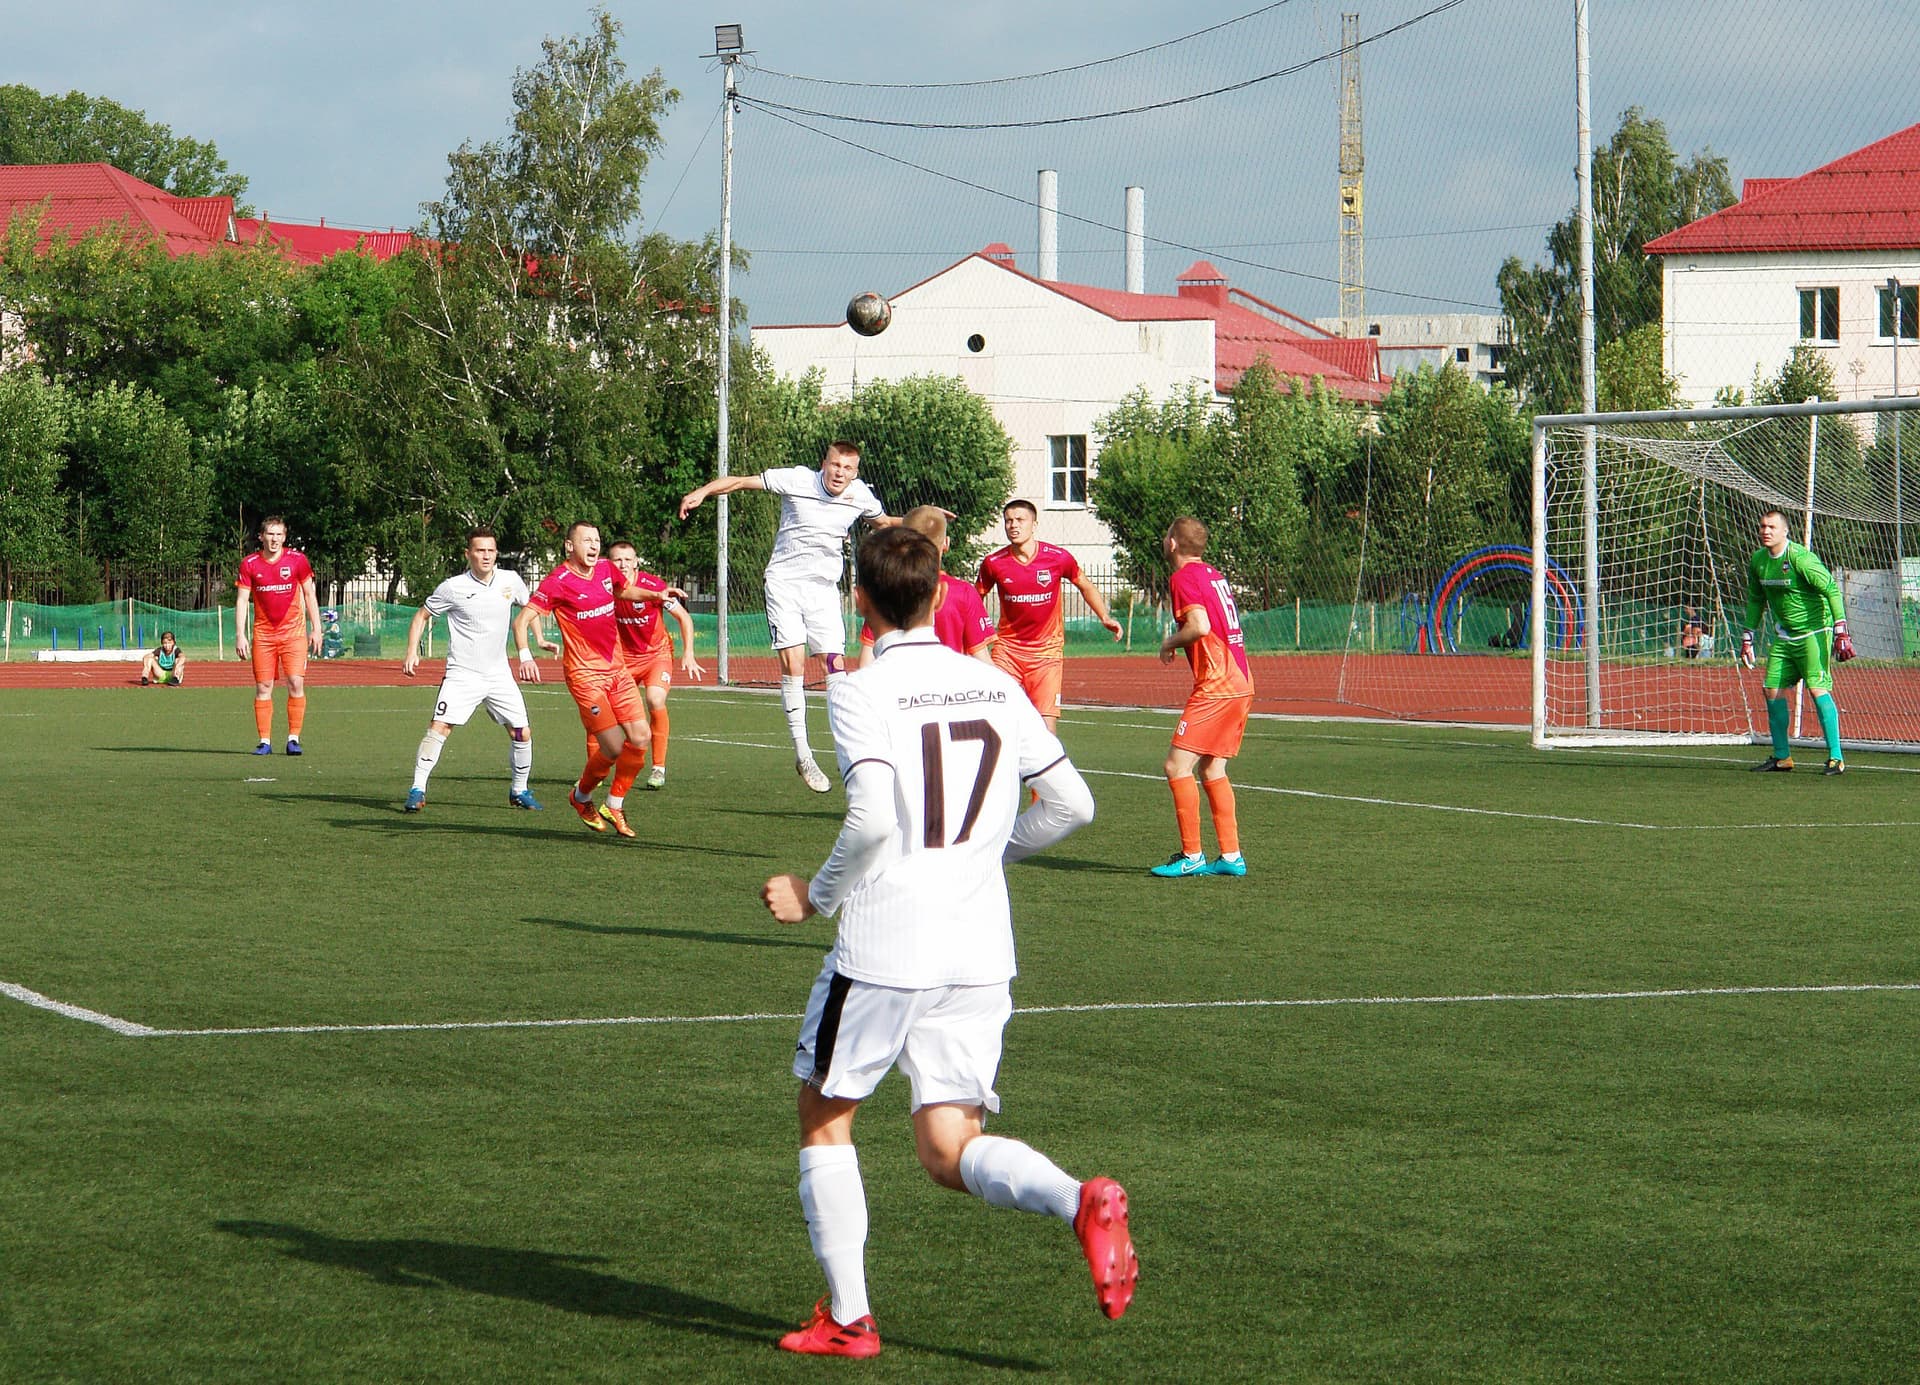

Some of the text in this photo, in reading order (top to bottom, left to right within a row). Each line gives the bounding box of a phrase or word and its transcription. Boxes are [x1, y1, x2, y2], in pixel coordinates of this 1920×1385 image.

[1210, 579, 1240, 630] 15
[436, 701, 448, 716] 9
[921, 718, 1002, 849] 17
